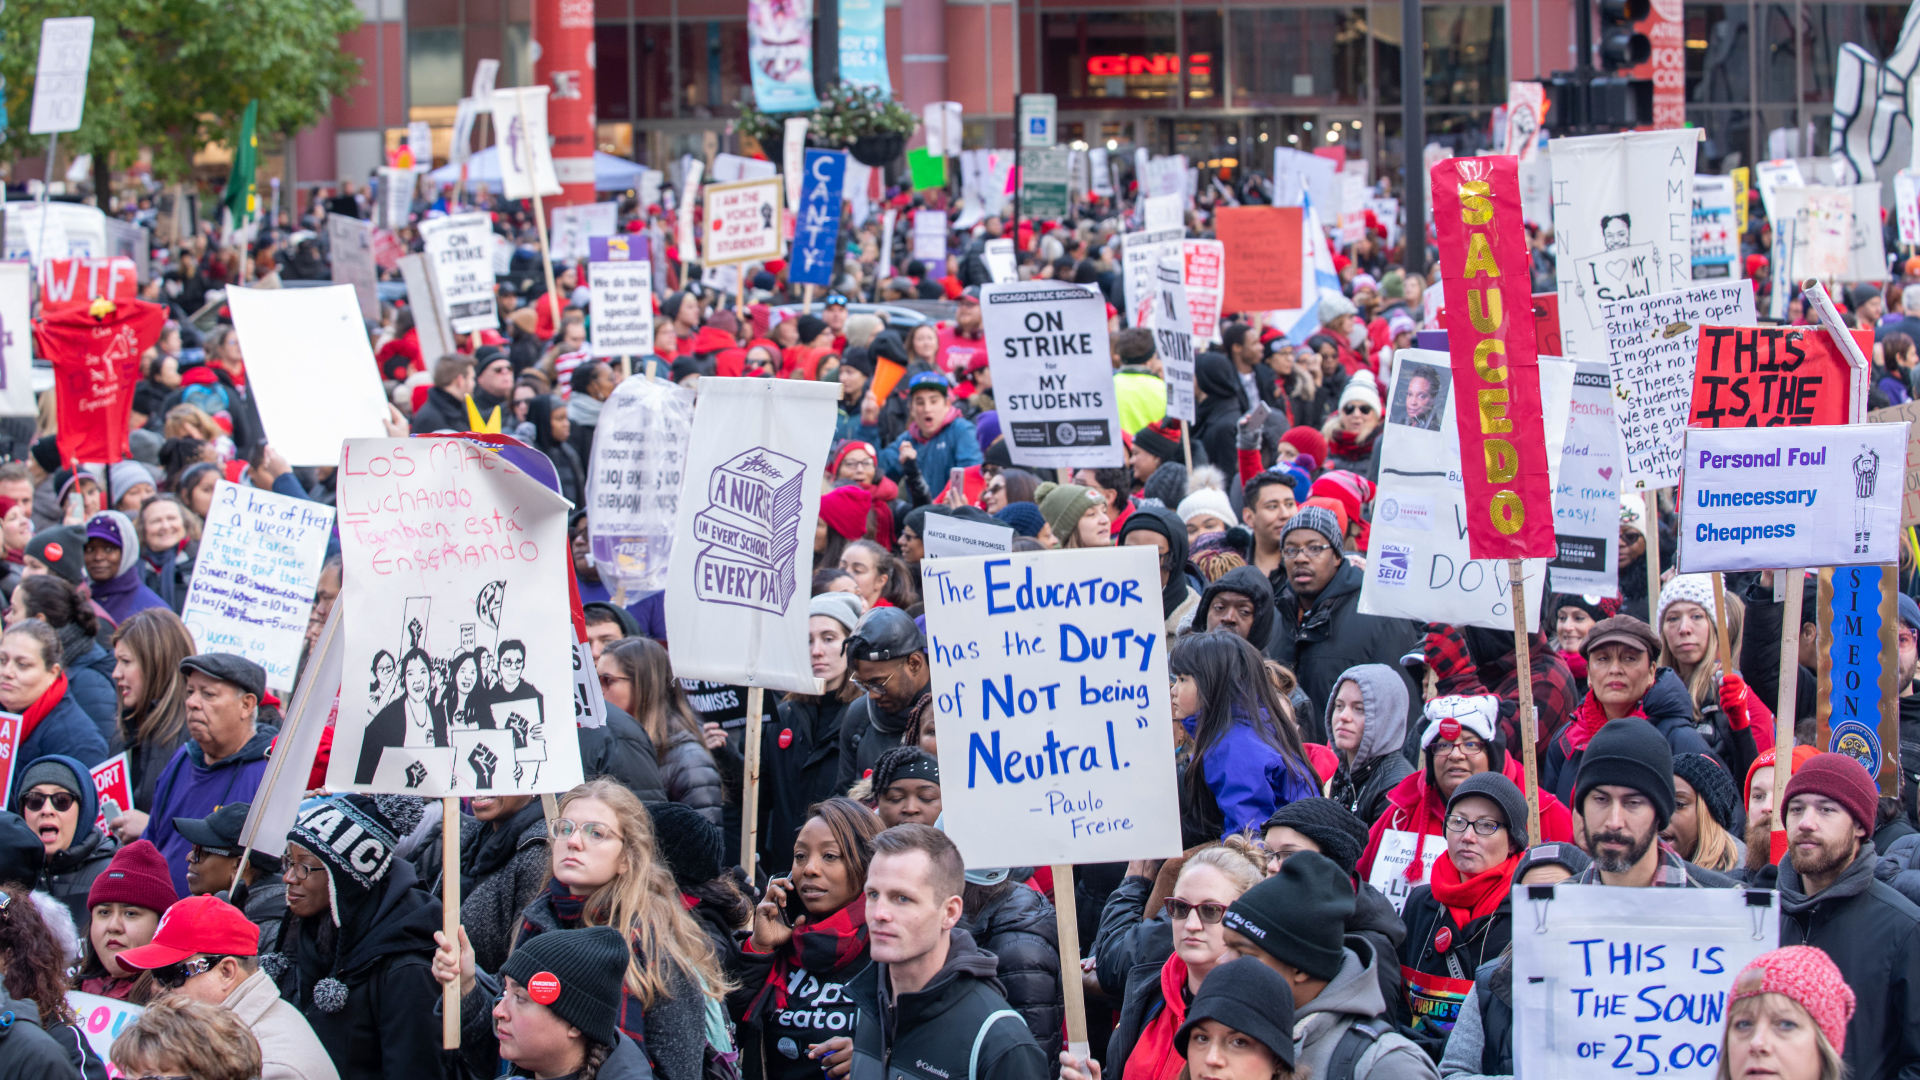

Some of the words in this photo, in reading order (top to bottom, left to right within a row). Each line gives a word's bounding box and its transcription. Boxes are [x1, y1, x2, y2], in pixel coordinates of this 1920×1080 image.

[840, 52, 866, 66] DEC
[723, 195, 739, 205] AM
[742, 191, 760, 202] THE
[726, 207, 757, 219] VOICE
[803, 155, 835, 273] CANTY
[449, 233, 468, 246] ON
[727, 224, 739, 236] OF
[745, 223, 758, 233] MY
[717, 236, 765, 252] STUDENTS
[441, 247, 484, 263] STRIKE
[45, 259, 136, 301] WTF
[453, 273, 476, 283] FAIR
[1589, 262, 1600, 285] I
[1631, 256, 1646, 278] MY
[447, 281, 492, 297] CONTRACT
[594, 278, 609, 287] We
[614, 278, 625, 287] do
[630, 277, 646, 287] this
[605, 292, 618, 302] for
[623, 294, 638, 302] our
[991, 293, 1026, 303] CHICAGO
[1027, 292, 1055, 301] PUBLIC
[1056, 290, 1092, 300] SCHOOLS
[1604, 303, 1634, 319] I'm
[1640, 295, 1683, 319] gonna
[1686, 287, 1718, 304] take
[1722, 288, 1742, 304] my
[604, 306, 641, 319] special
[1024, 310, 1064, 333] ON
[1607, 316, 1650, 335] Strike
[1654, 313, 1670, 326] to
[1673, 308, 1700, 323] the
[1706, 304, 1743, 322] open
[597, 321, 648, 333] education
[1004, 333, 1093, 358] STRIKE
[1158, 329, 1193, 363] STRIKE
[1610, 334, 1649, 350] road.
[1705, 328, 1806, 373] THIS
[1459, 180, 1526, 535] SAUCEDO
[1610, 351, 1637, 367] I'm
[1637, 341, 1680, 364] gonna
[1045, 362, 1057, 370] for
[1613, 369, 1625, 382] I
[1627, 361, 1662, 379] can't
[1668, 356, 1685, 370] no
[1039, 375, 1067, 391] MY
[1573, 372, 1610, 387] HOOLS
[1631, 372, 1685, 395] There's
[1009, 392, 1103, 411] STUDENTS
[1627, 387, 1690, 410] Students
[1696, 376, 1751, 418] IS
[1758, 375, 1823, 416] THE
[1618, 411, 1640, 425] We
[1644, 405, 1666, 418] are
[1621, 422, 1659, 441] We've
[1663, 415, 1685, 435] got
[1626, 435, 1667, 454] back.
[1699, 448, 1781, 468] Personal
[1788, 446, 1826, 467] Foul
[714, 474, 727, 505] A
[730, 477, 771, 526] NURSE
[1581, 486, 1616, 501] make
[1698, 489, 1818, 508] Unnecessary
[222, 487, 238, 508] 2
[247, 492, 275, 517] hrs
[280, 505, 298, 522] of
[301, 508, 333, 530] Prep
[1557, 507, 1597, 526] easy!
[231, 513, 241, 527] a
[255, 519, 305, 542] week?
[1696, 523, 1796, 545] Cheapness
[213, 523, 233, 538] If
[237, 532, 250, 545] it
[259, 535, 295, 556] takes
[699, 520, 708, 535] IN
[712, 525, 740, 547] EVERY
[740, 534, 770, 561] SCHOOL
[928, 530, 948, 541] MAYOR,
[948, 534, 962, 544] KEEP
[962, 537, 978, 547] YOUR
[978, 540, 1006, 551] PROMISES
[1382, 544, 1401, 552] LOCAL
[207, 552, 214, 561] a
[213, 539, 219, 551] 5
[222, 544, 246, 557] mins
[253, 552, 268, 562] to
[270, 555, 305, 570] grade
[1560, 549, 1596, 558] TEACHERS
[705, 562, 760, 600] EVERY
[1378, 568, 1407, 580] SEIU
[190, 593, 200, 604] 10
[206, 630, 244, 649] weeks
[250, 640, 265, 652] to
[933, 635, 980, 668] has
[1002, 630, 1046, 657] the
[1844, 568, 1863, 718] SIMEON
[938, 682, 965, 718] of
[1846, 726, 1863, 734] CAREER
[1071, 816, 1134, 839] Freire
[1232, 912, 1246, 925] You
[1244, 920, 1267, 939] Can't
[1568, 939, 1667, 978] THIS
[1692, 946, 1726, 975] IS
[1414, 999, 1448, 1017] PUBLIC
[1570, 987, 1629, 1019] THE
[1634, 985, 1725, 1026] SOUN
[1577, 1041, 1606, 1060] OF
[921, 1062, 950, 1080] Columbia
